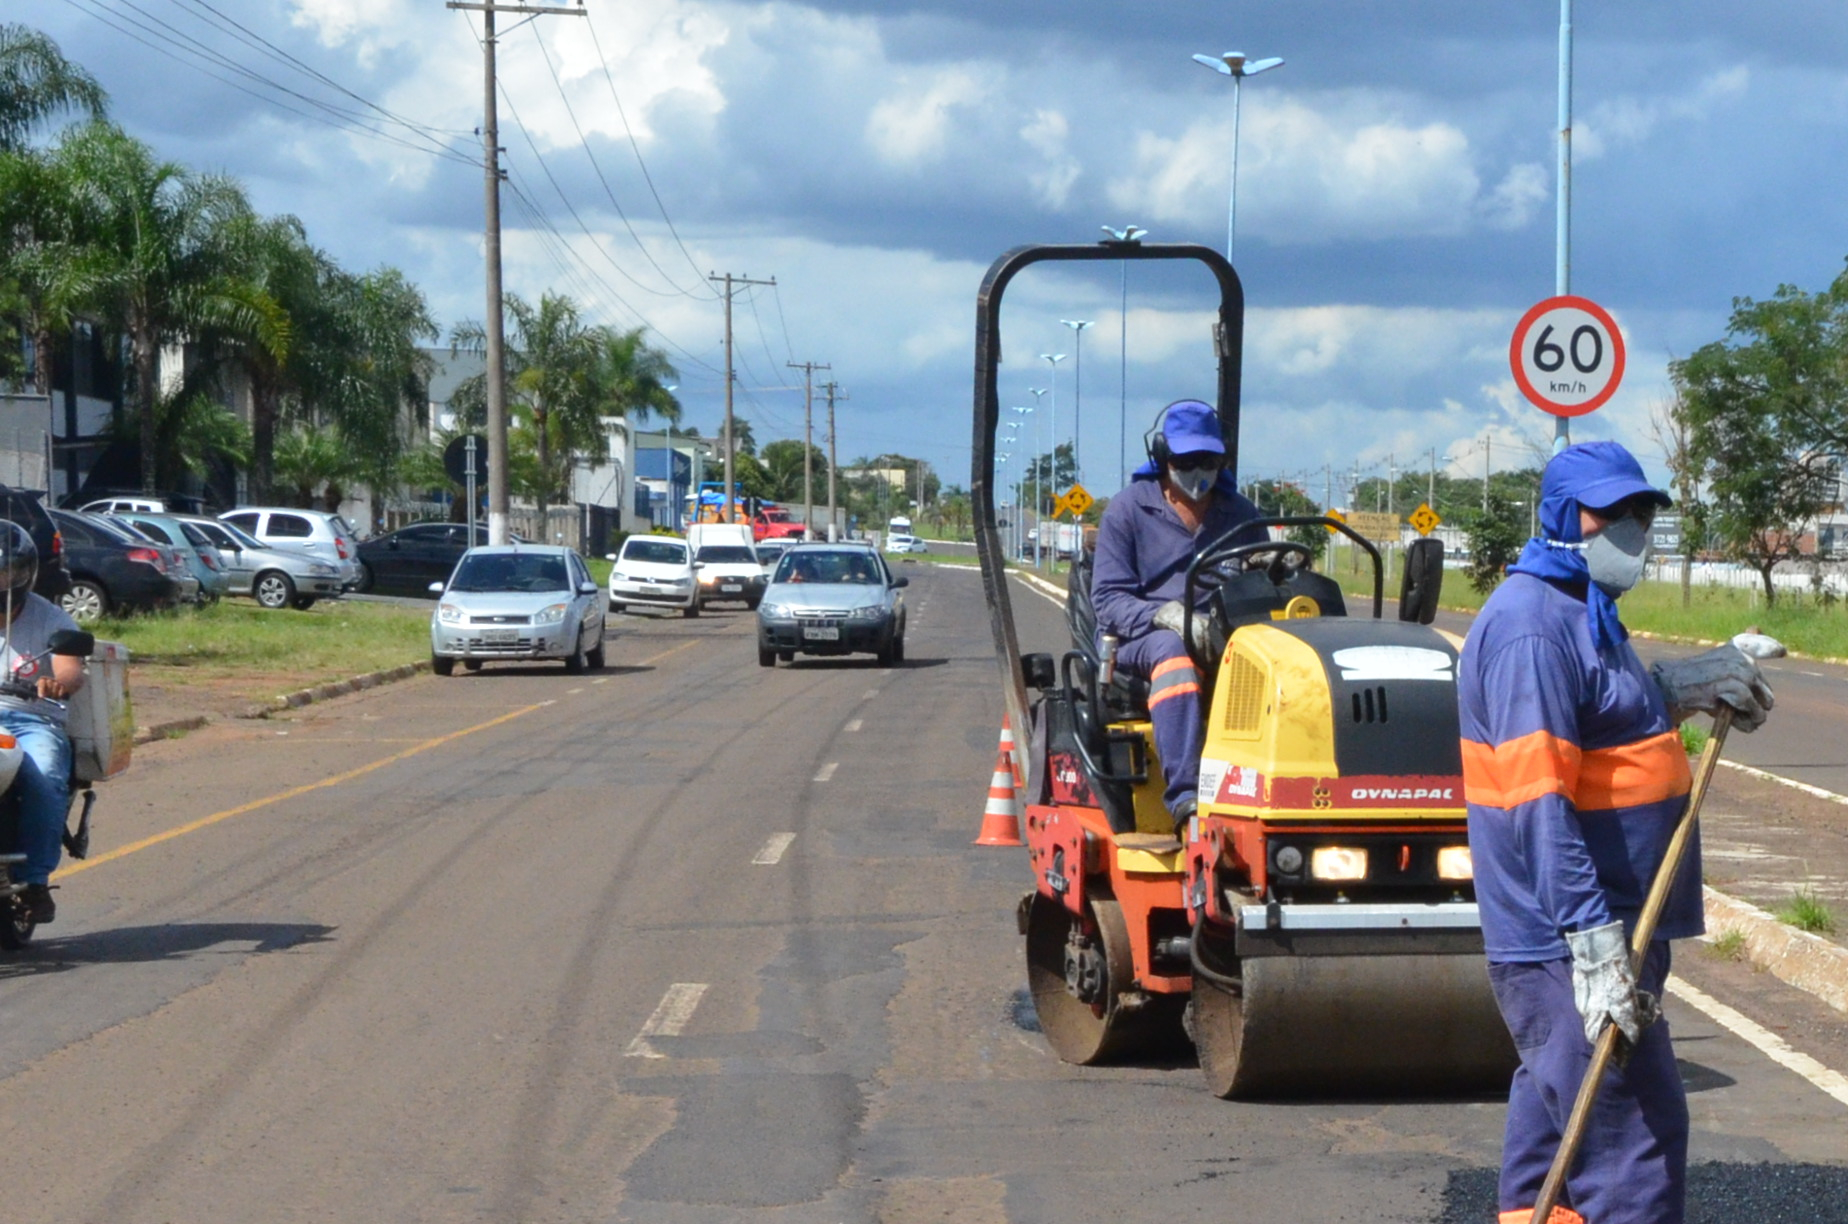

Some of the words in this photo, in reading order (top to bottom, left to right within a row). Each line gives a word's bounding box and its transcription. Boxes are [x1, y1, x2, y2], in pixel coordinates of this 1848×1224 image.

[1533, 324, 1603, 373] 60
[1550, 381, 1587, 393] km/h
[1351, 788, 1453, 800] DYNAPAC
